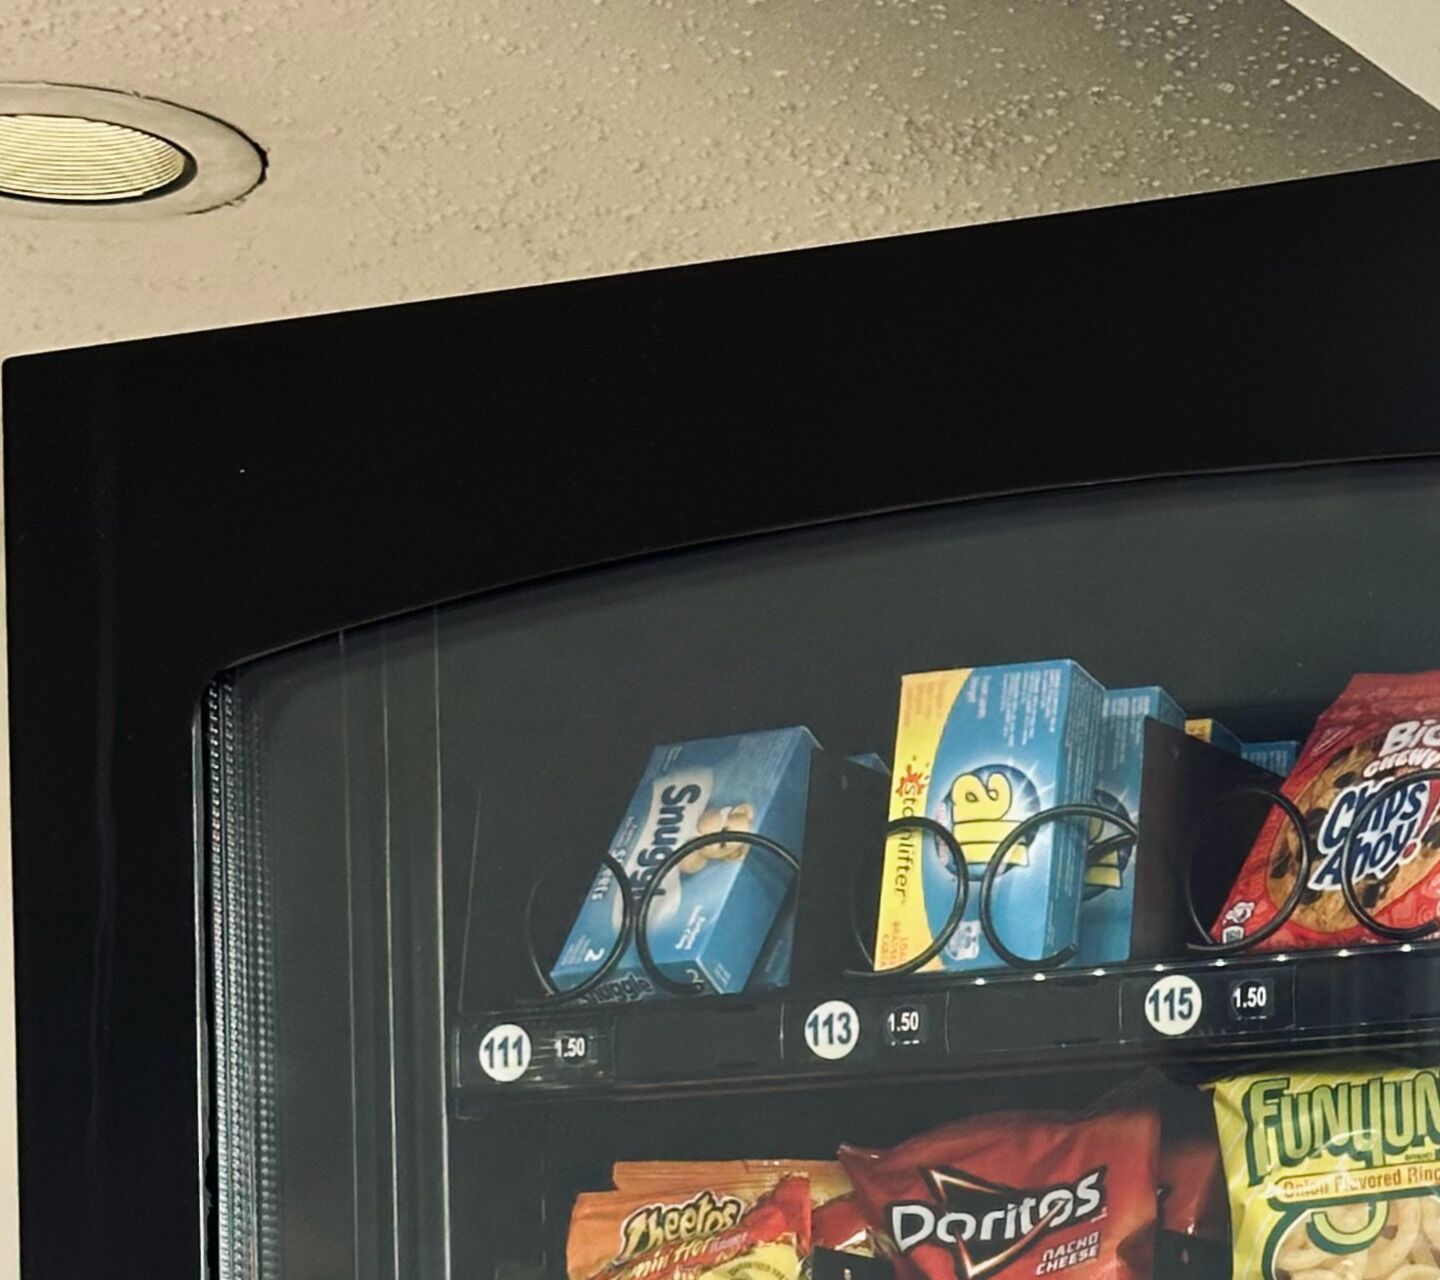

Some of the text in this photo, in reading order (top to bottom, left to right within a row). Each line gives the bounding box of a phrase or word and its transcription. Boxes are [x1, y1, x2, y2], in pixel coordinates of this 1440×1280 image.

[1148, 986, 1199, 1022] 115
[1232, 987, 1267, 1009] 1.50
[808, 1010, 853, 1045] 113
[886, 1012, 919, 1033] 1.50
[483, 1035, 527, 1070] 111
[555, 1037, 586, 1059] 1.50
[617, 1191, 744, 1262] Cheetos
[891, 1171, 1102, 1252] Doritos
[1035, 1246, 1099, 1276] CHEESE
[1042, 1231, 1099, 1262] NACHO
